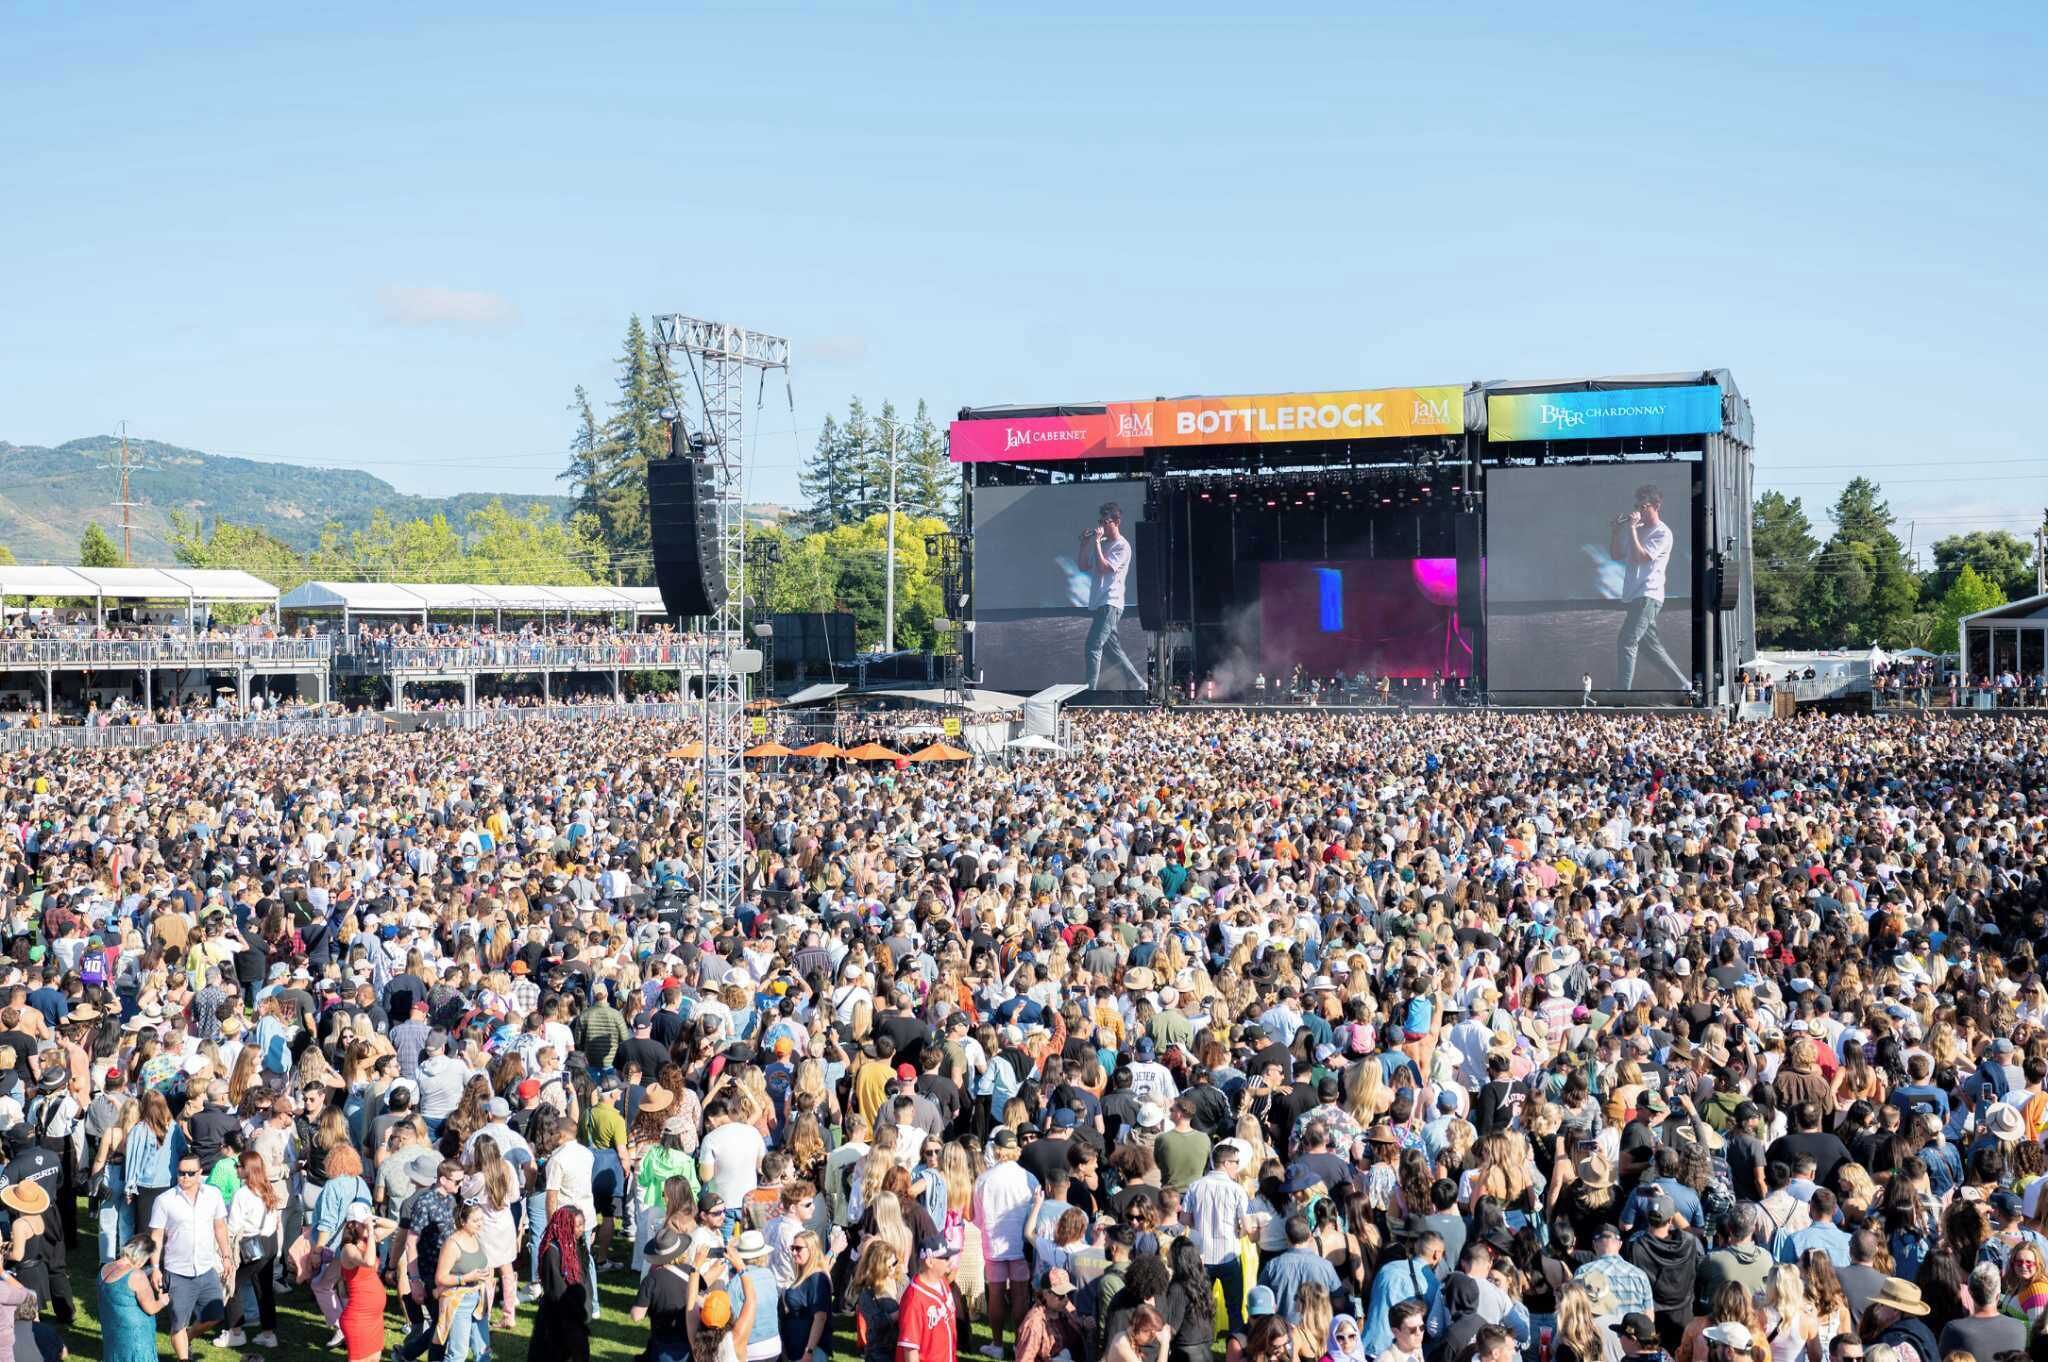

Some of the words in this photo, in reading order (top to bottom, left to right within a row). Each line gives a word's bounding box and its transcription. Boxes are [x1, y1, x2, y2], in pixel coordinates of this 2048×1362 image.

[1585, 405, 1666, 417] CHARDONNAY
[1177, 403, 1384, 434] BOTTLEROCK
[1032, 430, 1087, 442] CABERNET
[1135, 1071, 1156, 1082] JETER
